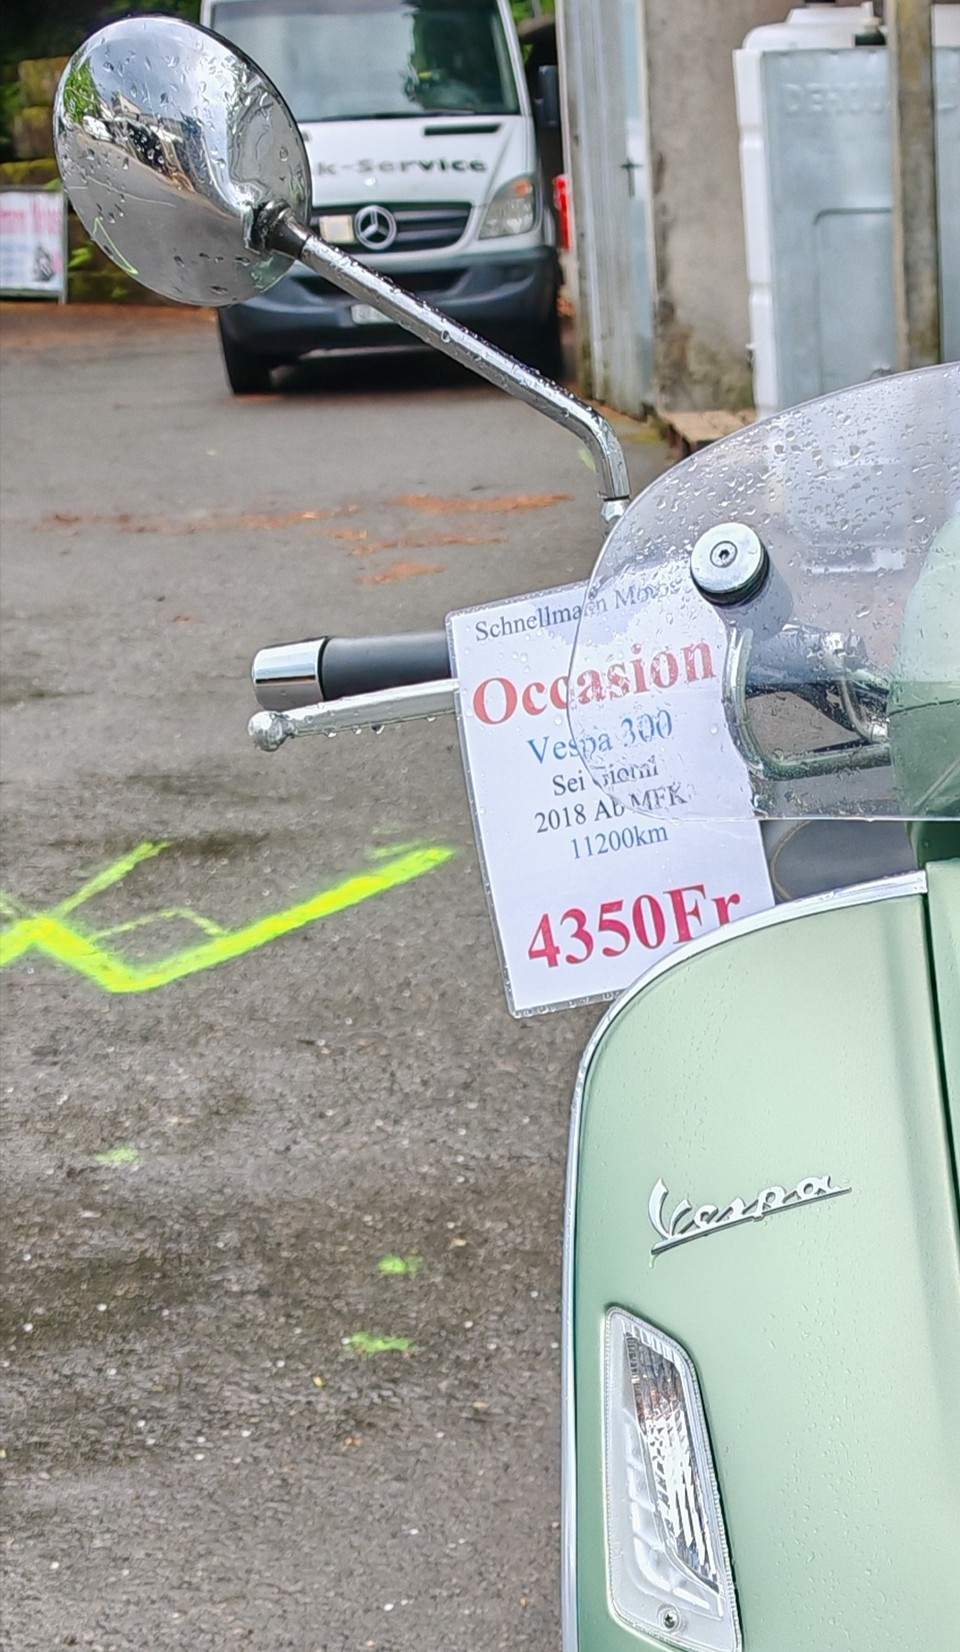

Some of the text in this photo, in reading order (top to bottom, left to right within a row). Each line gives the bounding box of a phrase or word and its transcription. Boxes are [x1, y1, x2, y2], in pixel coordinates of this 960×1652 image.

[473, 639, 716, 725] Occasion
[526, 709, 673, 765] Vespa 300
[534, 782, 689, 833] 2018 Ab MFK
[552, 769, 586, 796] Sei
[571, 824, 669, 860] 11200km
[528, 884, 741, 968] 4350Fr
[648, 1177, 851, 1252] Vespa
